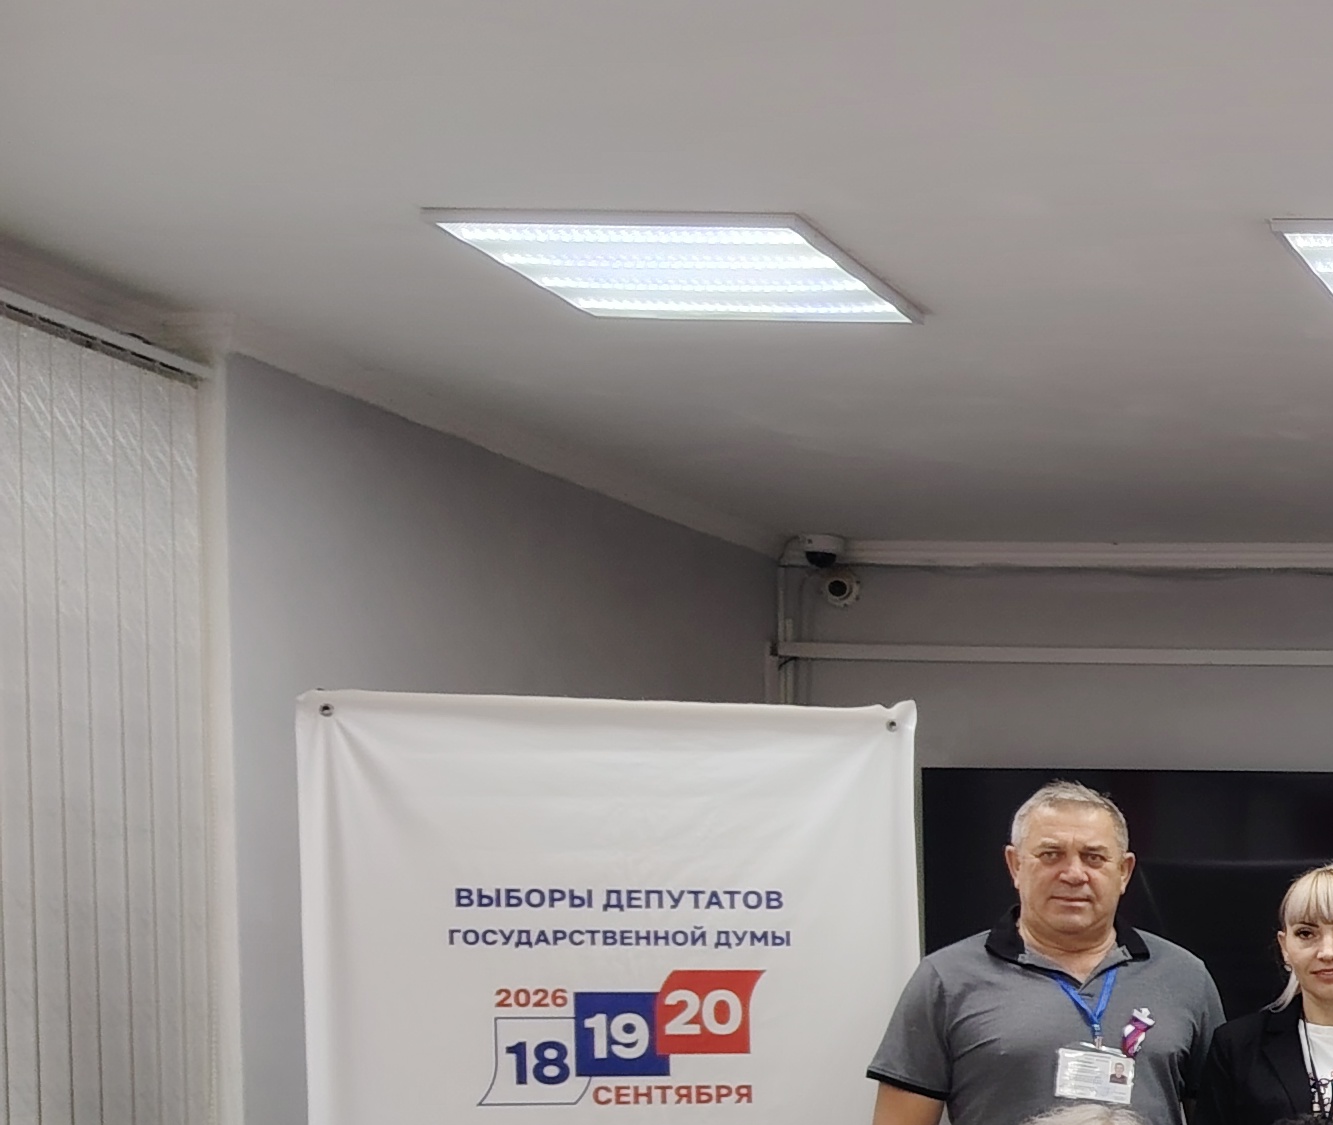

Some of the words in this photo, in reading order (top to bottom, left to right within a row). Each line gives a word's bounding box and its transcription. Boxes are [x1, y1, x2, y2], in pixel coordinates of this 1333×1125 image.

[454, 887, 593, 908] ВЫБОРЫ
[602, 889, 785, 912] ДЕПУТАТОВ
[448, 926, 708, 948] ГОСУДАРСТВЕННОЙ
[714, 930, 791, 949] ДУМЫ
[494, 988, 568, 1008] 2026
[505, 1040, 570, 1086] 18
[584, 1012, 650, 1060] 19
[664, 989, 743, 1036] 20
[592, 1084, 753, 1106] СЕНТЯБРЯ
